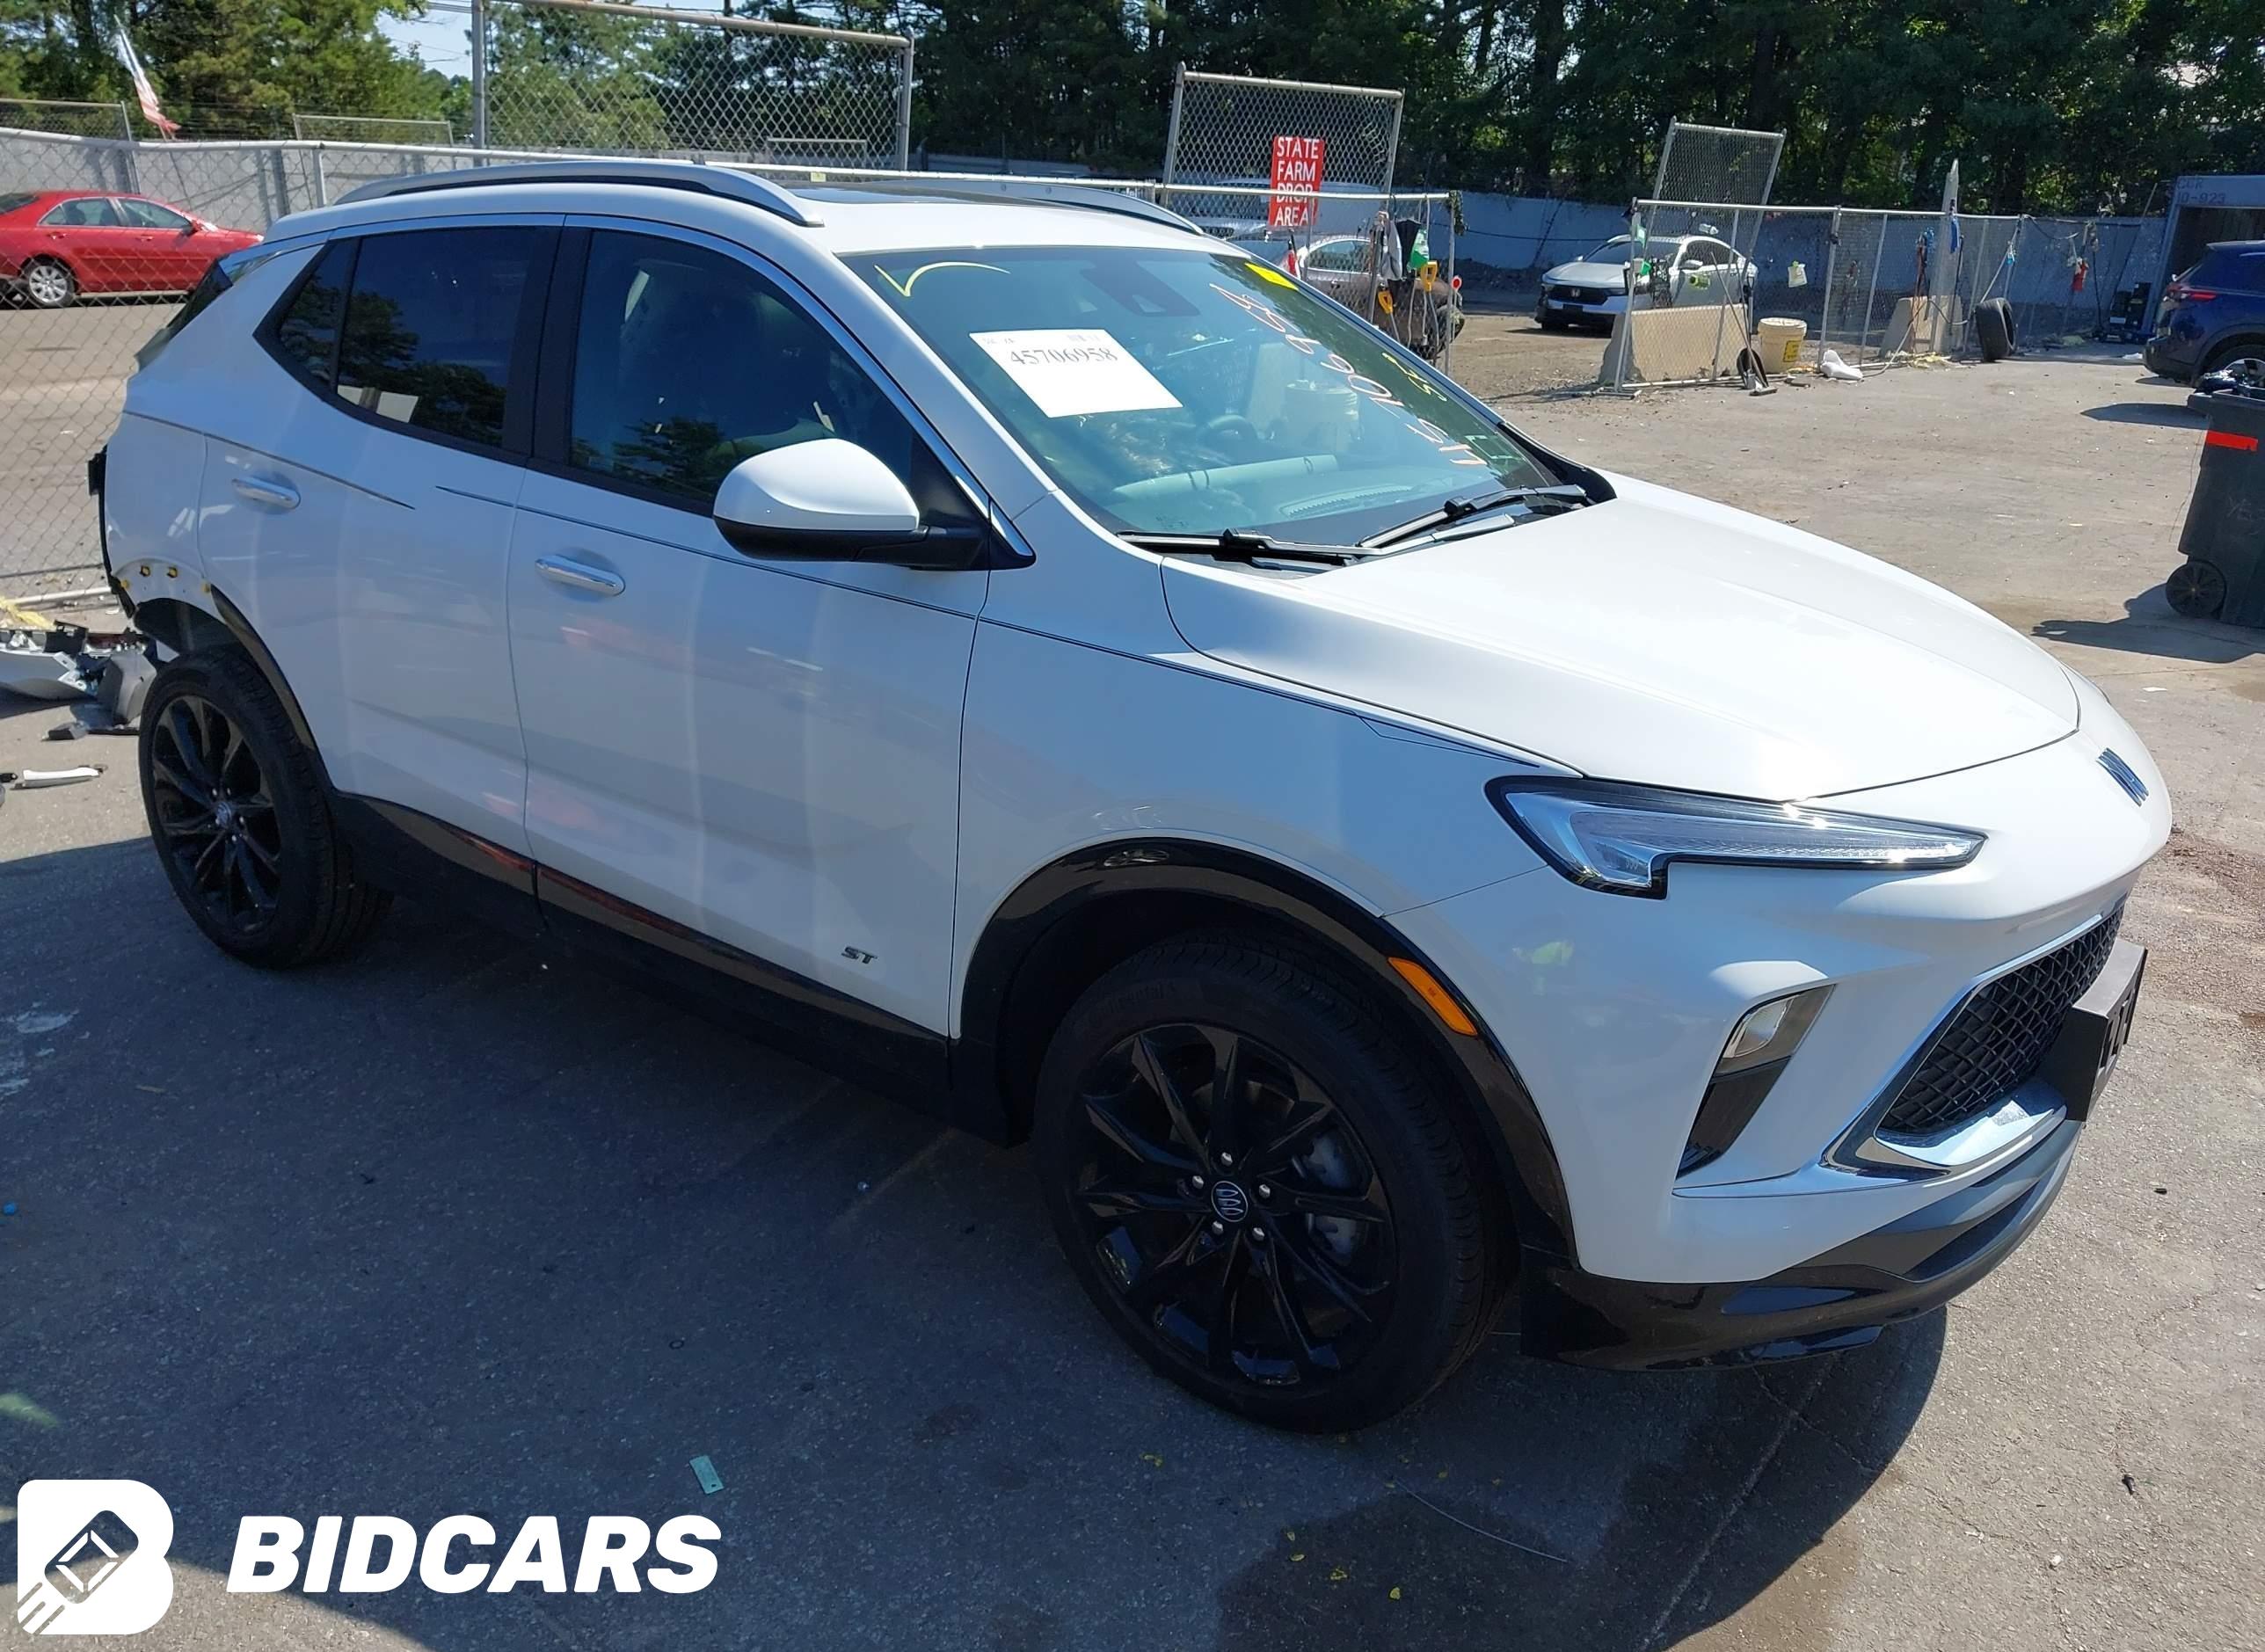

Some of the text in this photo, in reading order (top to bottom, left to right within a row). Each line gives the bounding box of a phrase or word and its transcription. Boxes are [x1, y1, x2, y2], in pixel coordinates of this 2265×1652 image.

[1277, 136, 1320, 160] STATE
[1277, 158, 1316, 182] FARM
[1276, 181, 1314, 204] DROP
[1273, 206, 1309, 227] AREA
[1010, 347, 1118, 365] 45706958
[841, 946, 878, 964] ST
